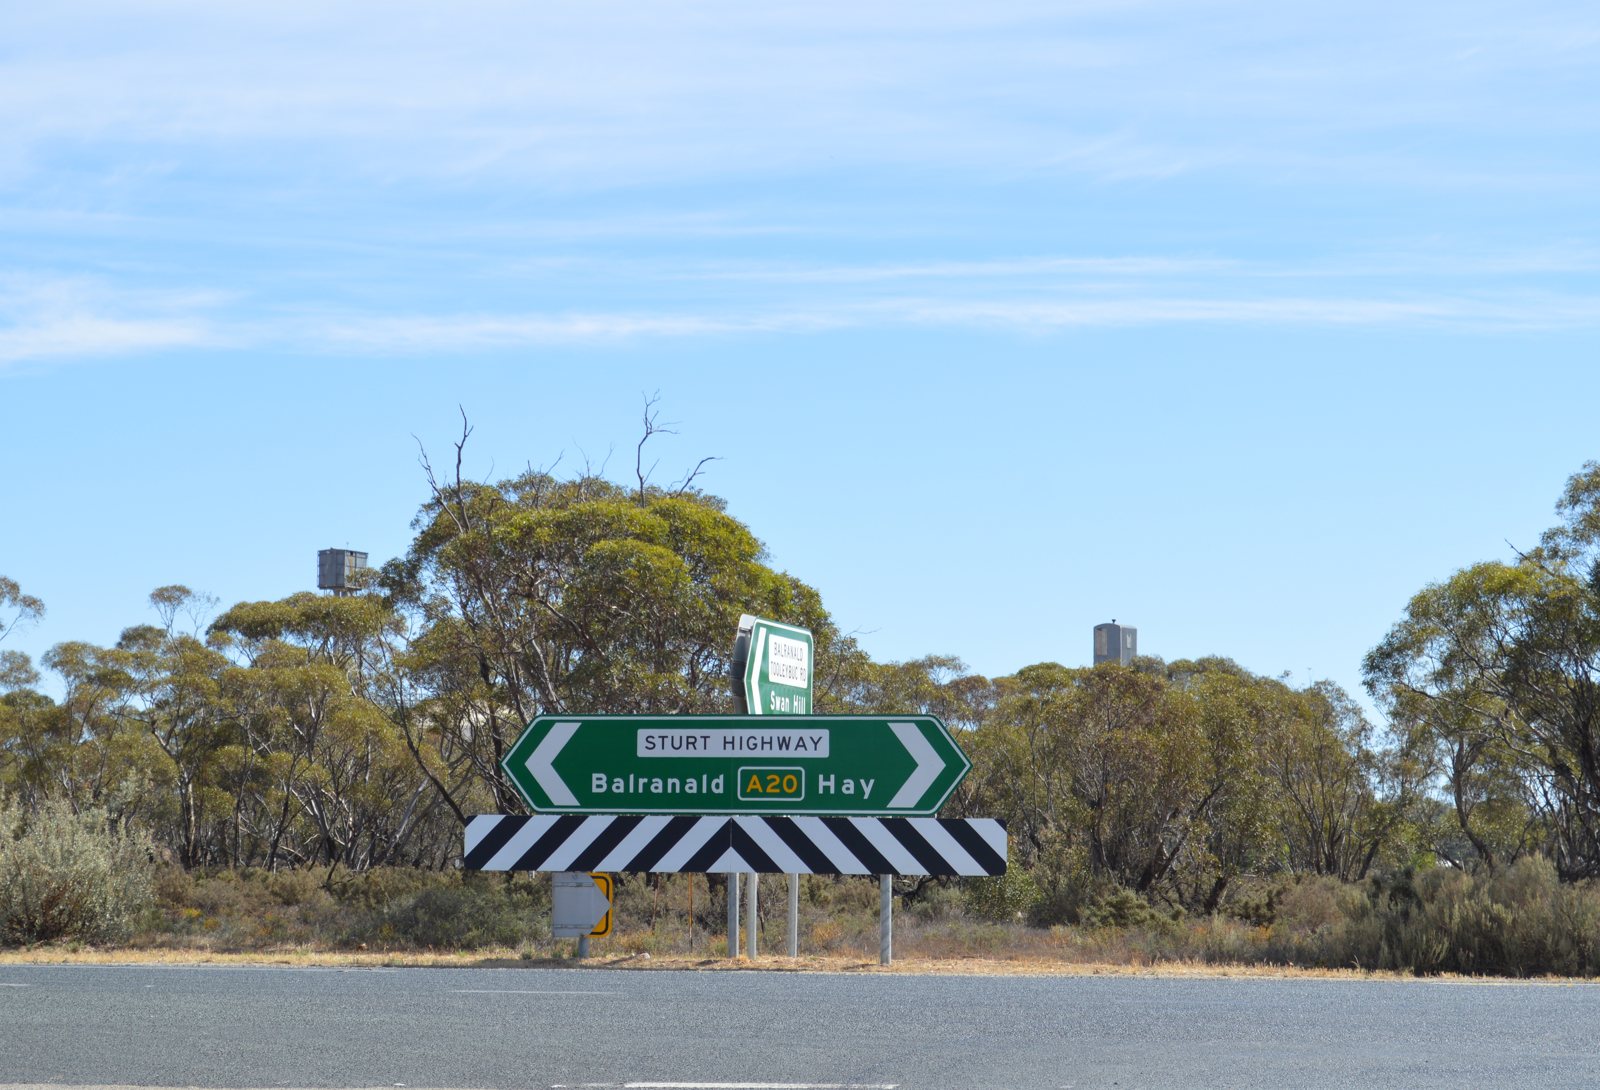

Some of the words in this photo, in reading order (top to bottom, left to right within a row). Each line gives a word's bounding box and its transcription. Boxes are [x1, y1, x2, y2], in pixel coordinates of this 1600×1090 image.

[774, 642, 803, 662] BALRANALD
[771, 661, 798, 680] TOOLEYBUC
[800, 667, 806, 682] RD
[770, 690, 790, 712] Swan
[793, 694, 805, 714] Hill
[645, 736, 711, 751] STURT
[723, 736, 823, 751] HIGHWAY
[591, 773, 724, 794] Balranald
[746, 774, 798, 793] A20
[818, 774, 875, 799] Hay
